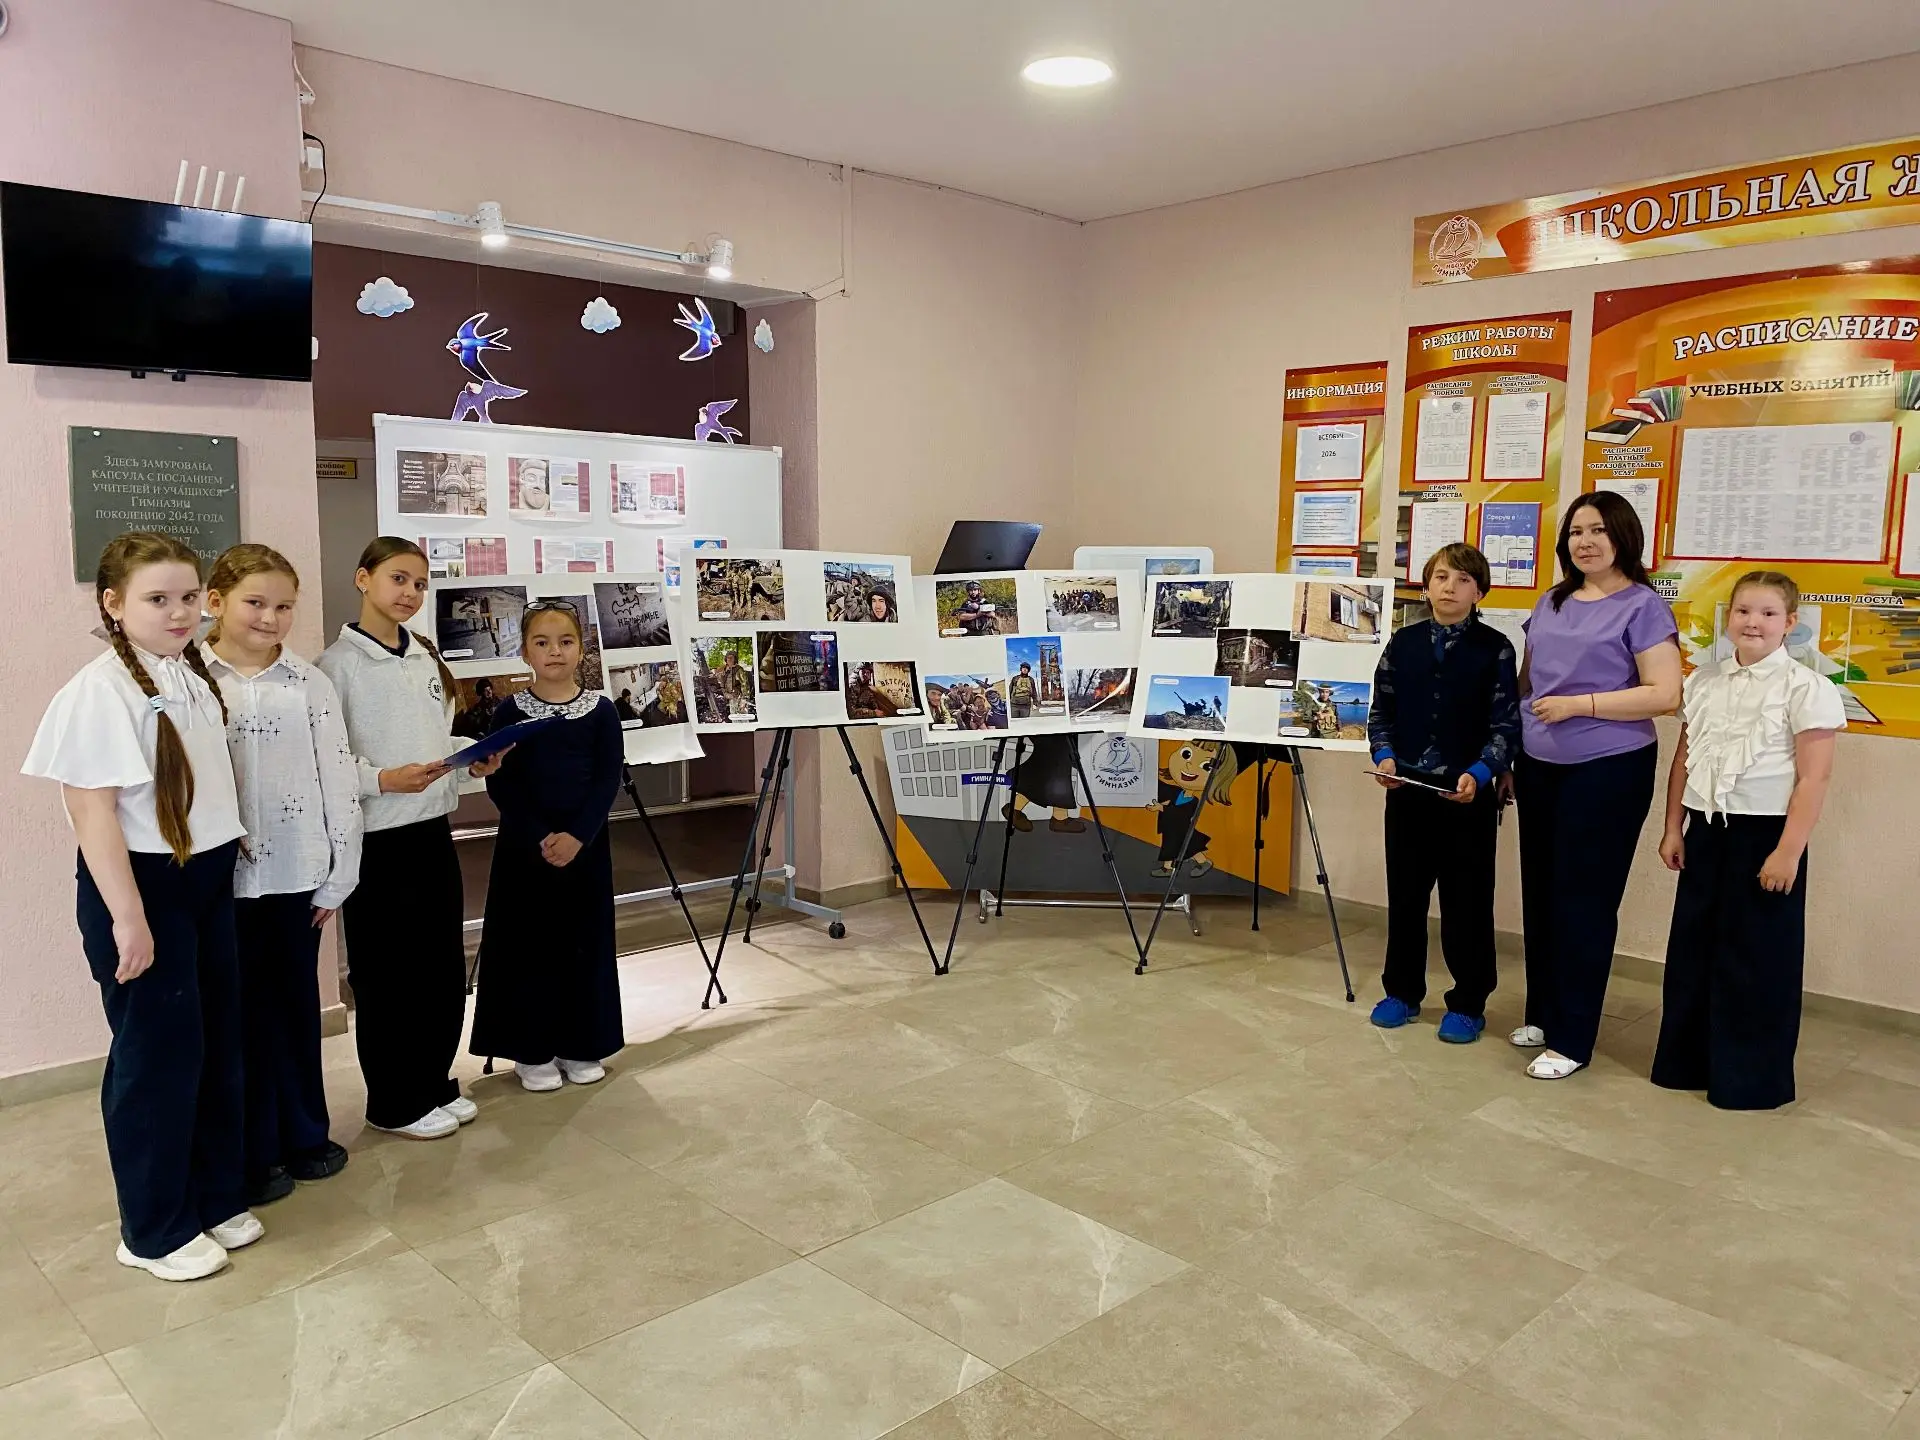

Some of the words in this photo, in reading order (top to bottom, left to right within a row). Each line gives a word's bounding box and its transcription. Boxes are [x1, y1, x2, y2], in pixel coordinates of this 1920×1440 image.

[1535, 160, 1875, 247] ШКОЛЬНАЯ
[1432, 258, 1479, 277] ГИМНАЗИЯ
[1421, 329, 1481, 351] РЕЖИМ
[1485, 326, 1555, 340] РАБОТЫ
[1673, 315, 1920, 361] РАСПИСАНИЕ
[1452, 344, 1519, 362] ШКОЛЫ
[1286, 381, 1385, 400] ИНФОРМАЦИЯ
[1426, 381, 1472, 390] РАСПИСАНИЕ
[1689, 380, 1785, 398] УЧЕБНЫХ
[1790, 370, 1893, 392] ЗАНЯТИЙ
[1602, 446, 1652, 454] РАСПИСАНИЕ
[103, 455, 139, 467] ЗДЕСЬ
[141, 458, 213, 472] ЗАМУРОВАНА
[1590, 461, 1663, 469] ОБРАЗОВАТЕЛЬНЫХ
[91, 469, 144, 481] КАПСУЛА
[157, 473, 223, 485] ПОСЛАНИЕМ
[92, 483, 150, 494] УЧИТЕЛЕЙ
[163, 486, 223, 497] УЧАЩИХСЯ
[95, 509, 166, 521] ПОКОЛЕНИЮ
[169, 510, 195, 522] 2042
[197, 512, 224, 523] ГОДА
[1855, 595, 1904, 605] ДОСУГА
[971, 775, 1005, 783] ГИМНИЯ
[1095, 775, 1140, 789] ГИМНАЗИЯ
